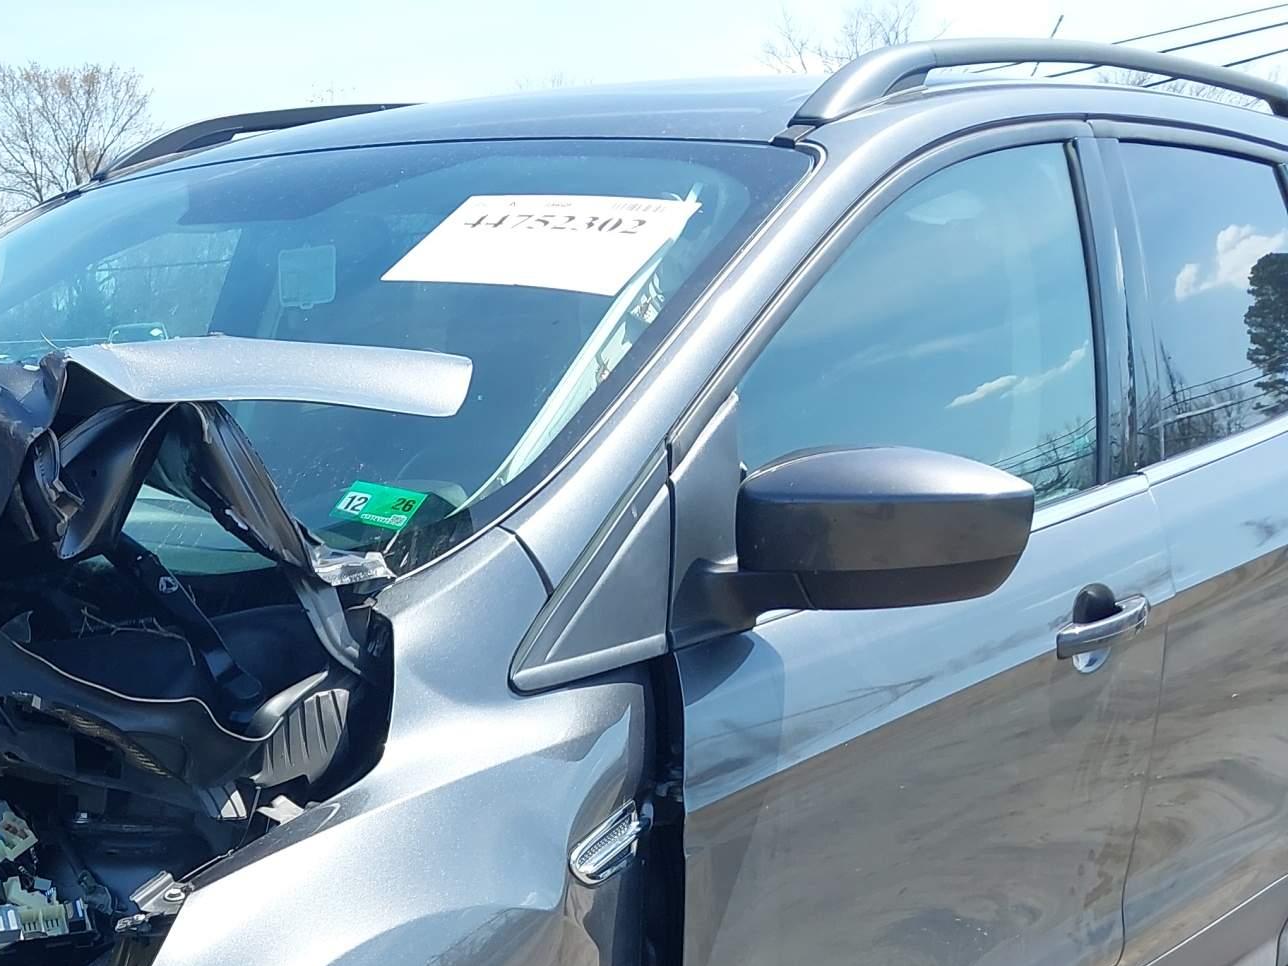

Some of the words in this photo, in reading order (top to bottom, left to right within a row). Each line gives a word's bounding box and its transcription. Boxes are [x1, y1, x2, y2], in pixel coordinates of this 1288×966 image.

[464, 213, 648, 235] 44752302
[344, 494, 369, 512] 12
[392, 497, 417, 513] 26
